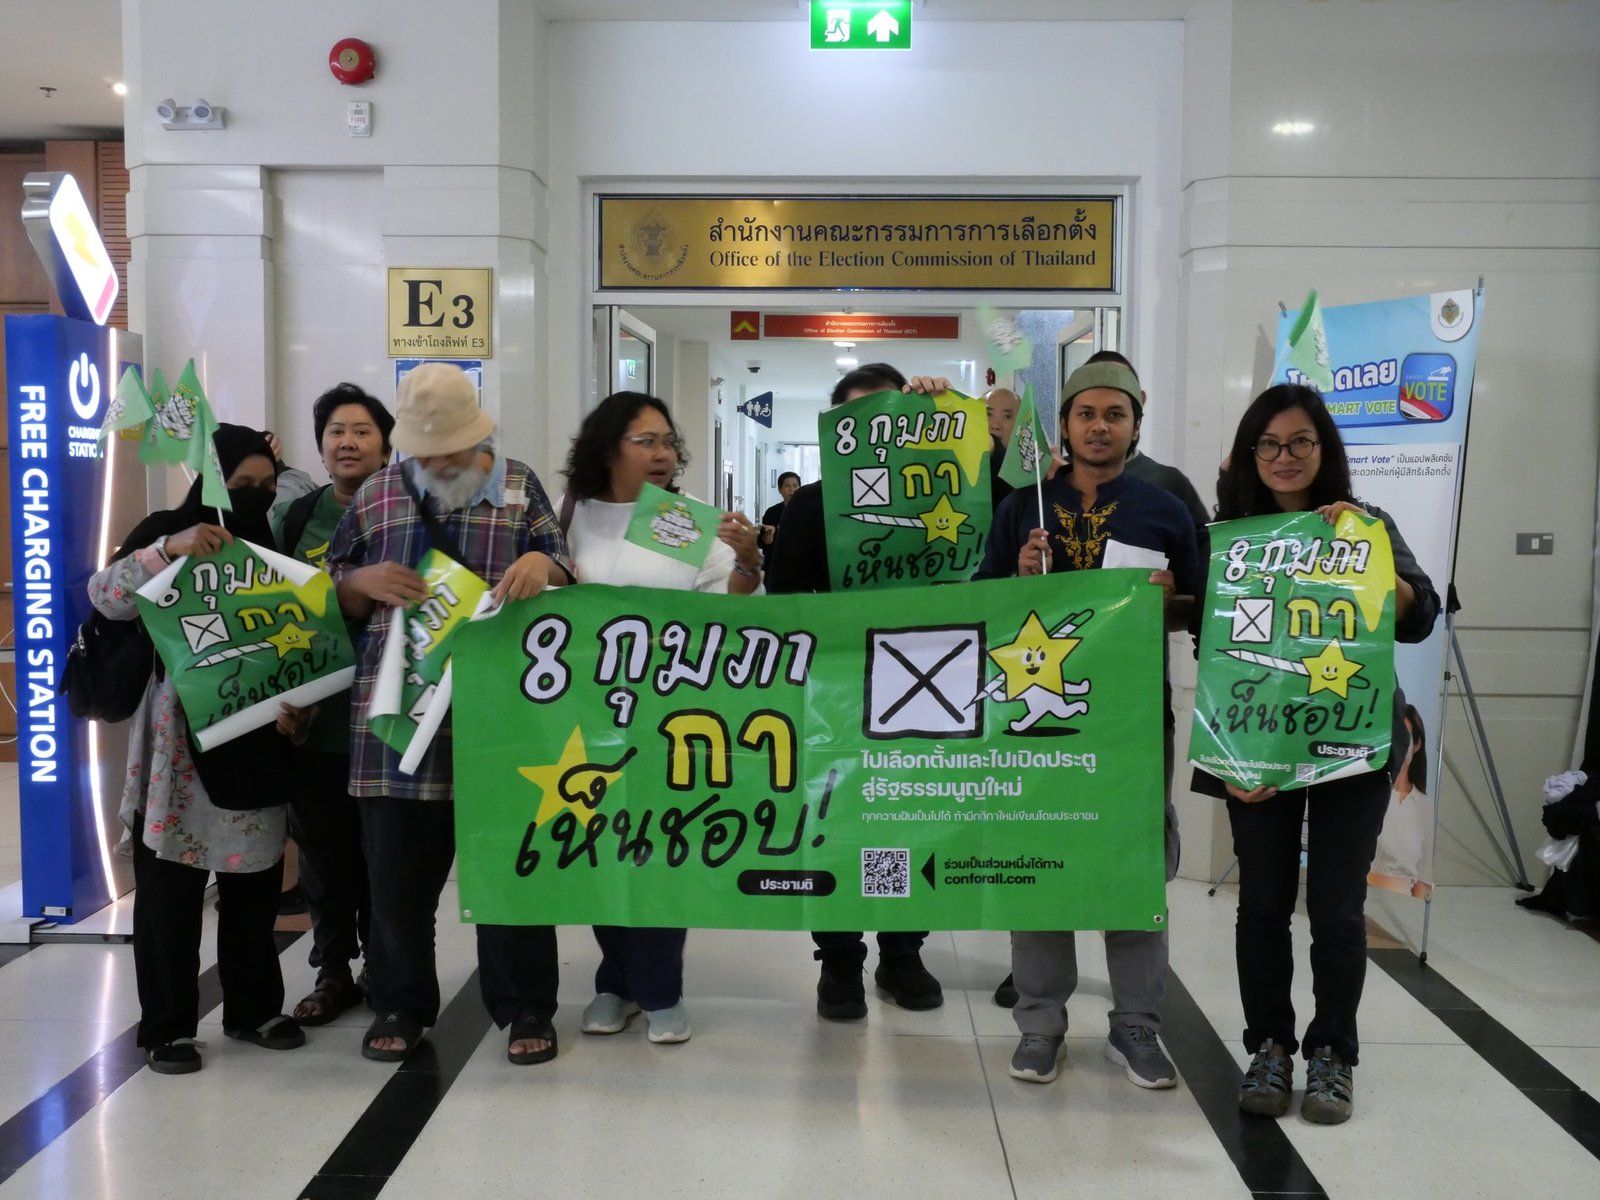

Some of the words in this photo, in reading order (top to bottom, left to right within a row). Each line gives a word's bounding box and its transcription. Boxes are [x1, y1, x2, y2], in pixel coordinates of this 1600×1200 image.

[709, 208, 1097, 242] สำนักงานคณะกรรมการการเลือกตั้ง
[709, 250, 762, 267] Office
[765, 250, 784, 267] of
[787, 250, 815, 267] the
[819, 250, 885, 267] Election
[891, 250, 993, 267] Commission
[999, 250, 1016, 266] of
[1021, 250, 1096, 266] Thailand
[393, 335, 468, 348] ทางเข้าโถงลิฟท์
[472, 338, 485, 348] E3
[1405, 381, 1448, 401] VOTE
[20, 385, 48, 459] FREE
[1326, 402, 1361, 415] MART
[1366, 401, 1397, 414] VOTE
[68, 425, 101, 440] CHARGIN
[835, 417, 858, 455] 8
[868, 411, 967, 463] กุมภา
[69, 441, 104, 458] STATIO
[900, 460, 961, 499] กา
[22, 468, 53, 640] CHARGING
[843, 529, 983, 588] เห็นชอบ!
[1224, 539, 1251, 583] 8
[1257, 536, 1371, 594] กุมภา
[236, 602, 307, 632] กา
[1284, 597, 1357, 641] กา
[520, 613, 573, 705] 8
[594, 615, 818, 728] กุมภา
[27, 648, 57, 783] STATION
[1207, 672, 1380, 736] เห็นชอบ!
[658, 708, 798, 793] กา
[862, 745, 1097, 774] ไปเลือกตั้งและไปเปิดประตู
[862, 776, 1023, 803] สู่รัฐธรรมนูญใหม่
[515, 746, 838, 878] เห็นชอบ!
[861, 810, 952, 824] ทุกความฝันเป็นไปได้
[954, 809, 1099, 822] ถ้ามีกติกาใหม่เขียนโดยประชาชน
[944, 854, 1065, 870] ร่วมเป็นส่วนหนึ่งได้ทาง
[760, 876, 814, 892] ประชามติ
[944, 872, 1037, 886] conforall.com
